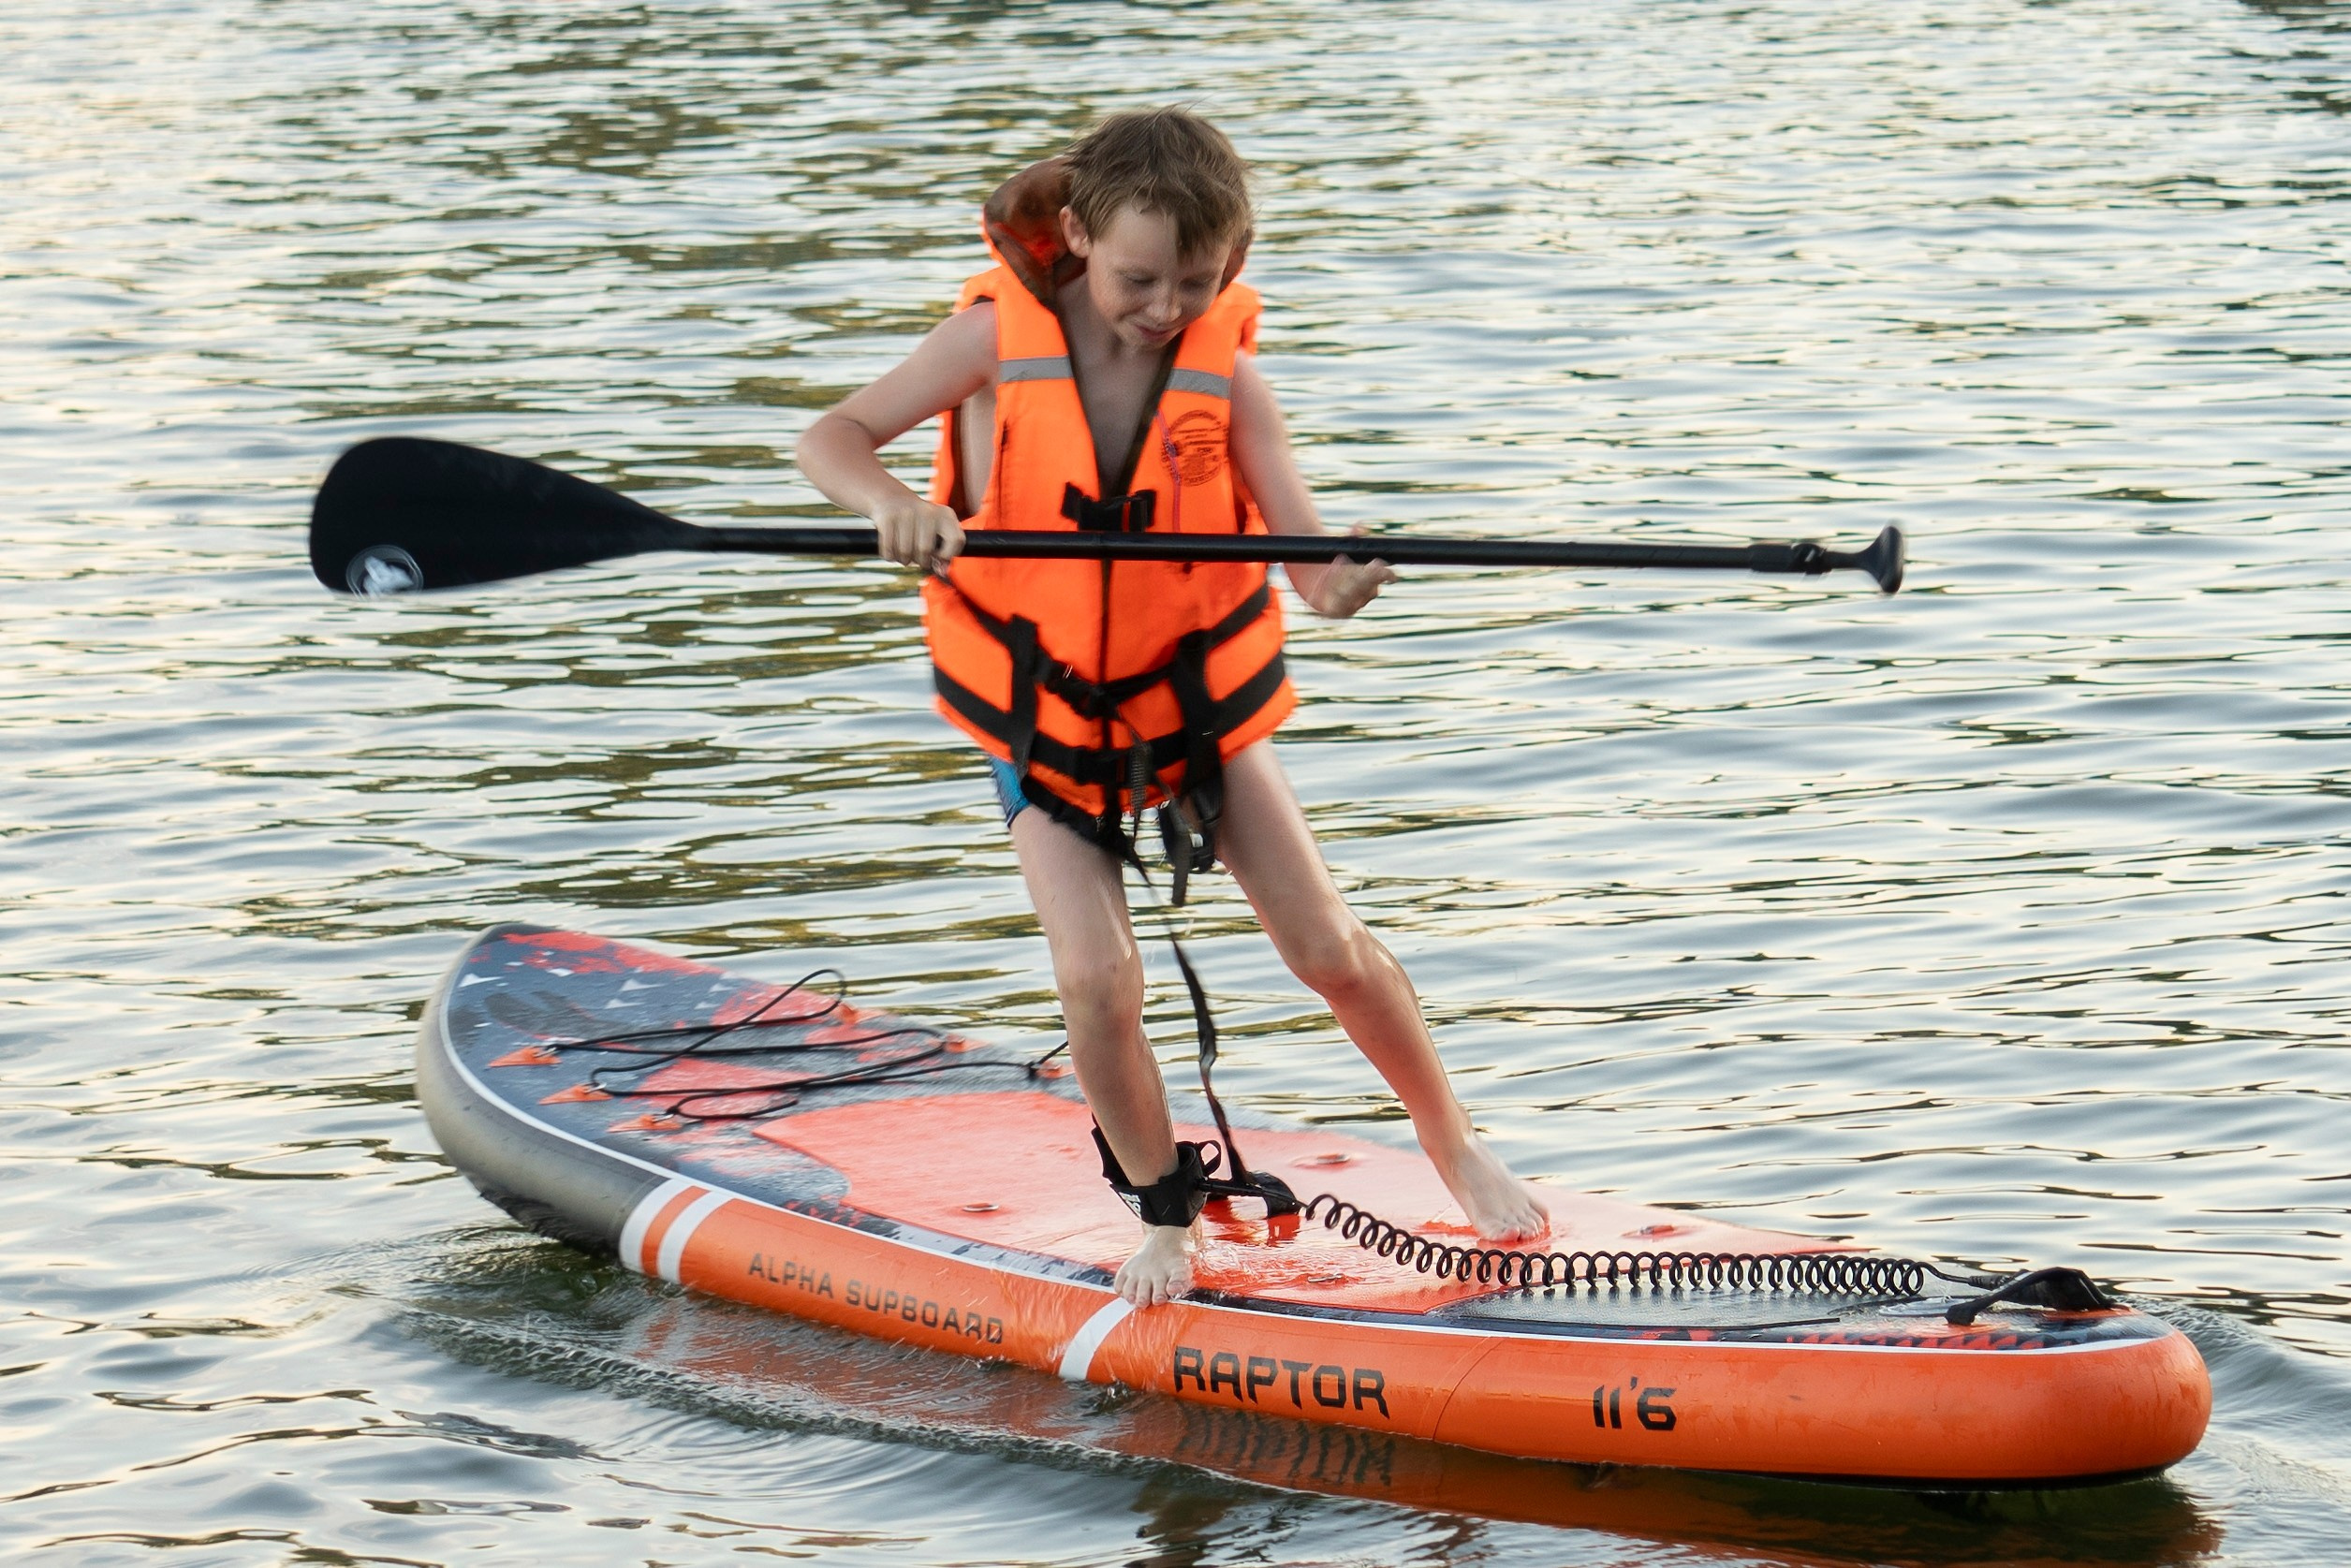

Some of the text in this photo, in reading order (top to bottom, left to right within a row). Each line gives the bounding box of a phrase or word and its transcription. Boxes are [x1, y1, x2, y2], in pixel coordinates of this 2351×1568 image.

[748, 1253, 1004, 1344] ALPHA SUPBOARD
[1173, 1345, 1389, 1420] RAPTOR
